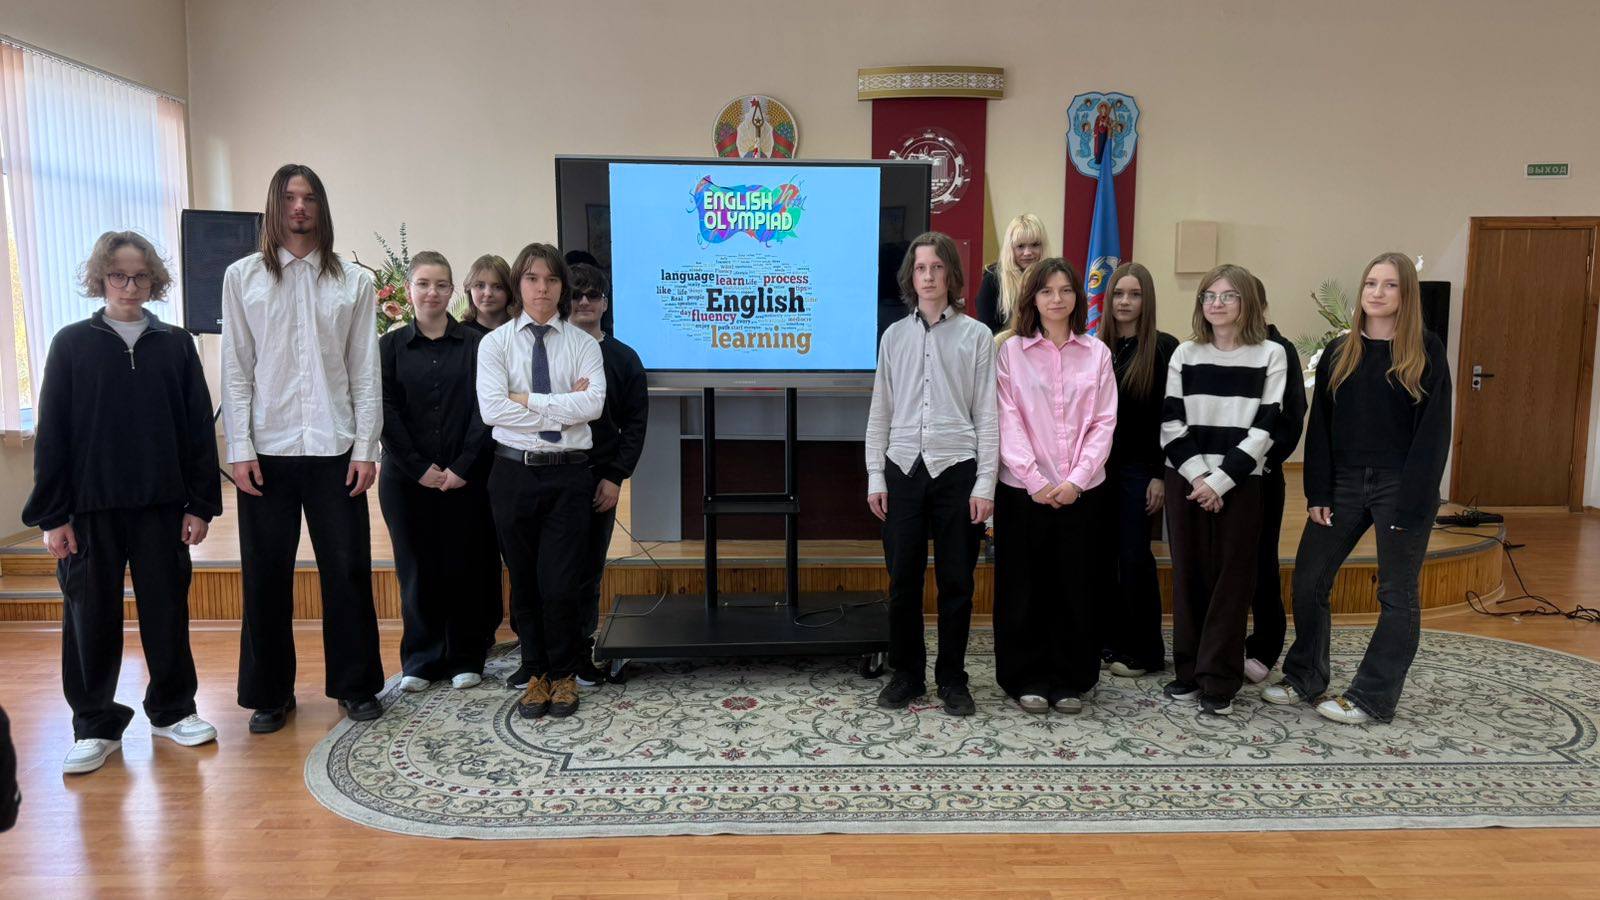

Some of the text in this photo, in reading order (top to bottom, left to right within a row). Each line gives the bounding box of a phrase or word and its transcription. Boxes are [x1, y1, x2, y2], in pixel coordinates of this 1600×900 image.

[1527, 165, 1567, 174] ВЫХОД
[703, 191, 773, 211] ENGLISH
[703, 211, 793, 231] OLYMPIAD
[660, 268, 715, 284] language
[716, 273, 745, 286] learn
[763, 274, 809, 287] process
[656, 285, 672, 295] like
[706, 287, 806, 319] English
[680, 309, 691, 318] day
[691, 309, 737, 325] fluency
[710, 325, 812, 355] learning
